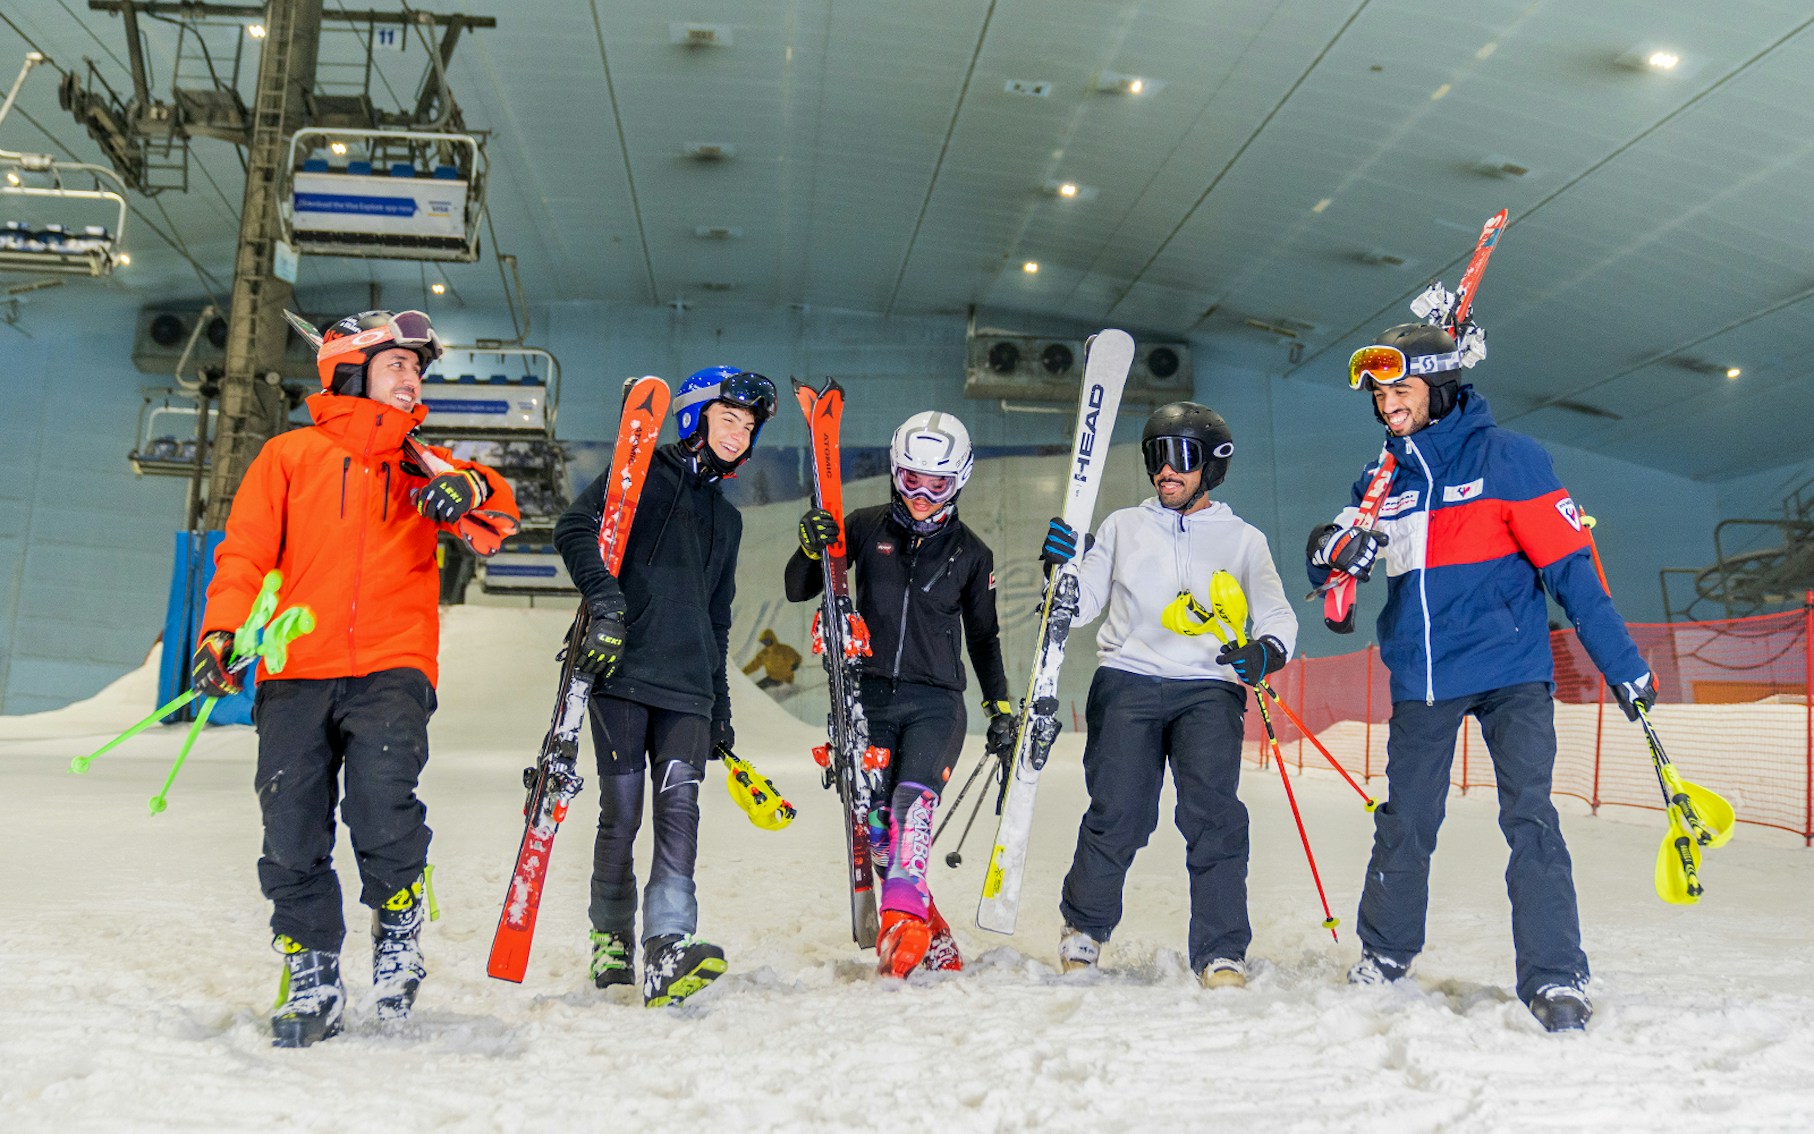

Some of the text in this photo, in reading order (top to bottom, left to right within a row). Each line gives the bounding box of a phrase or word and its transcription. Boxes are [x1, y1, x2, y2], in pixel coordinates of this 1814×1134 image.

[378, 30, 394, 45] 11
[1073, 384, 1104, 482] HEAD
[823, 433, 832, 479] ATOMIC
[439, 481, 463, 504] LEKI
[598, 634, 622, 646] LEKI
